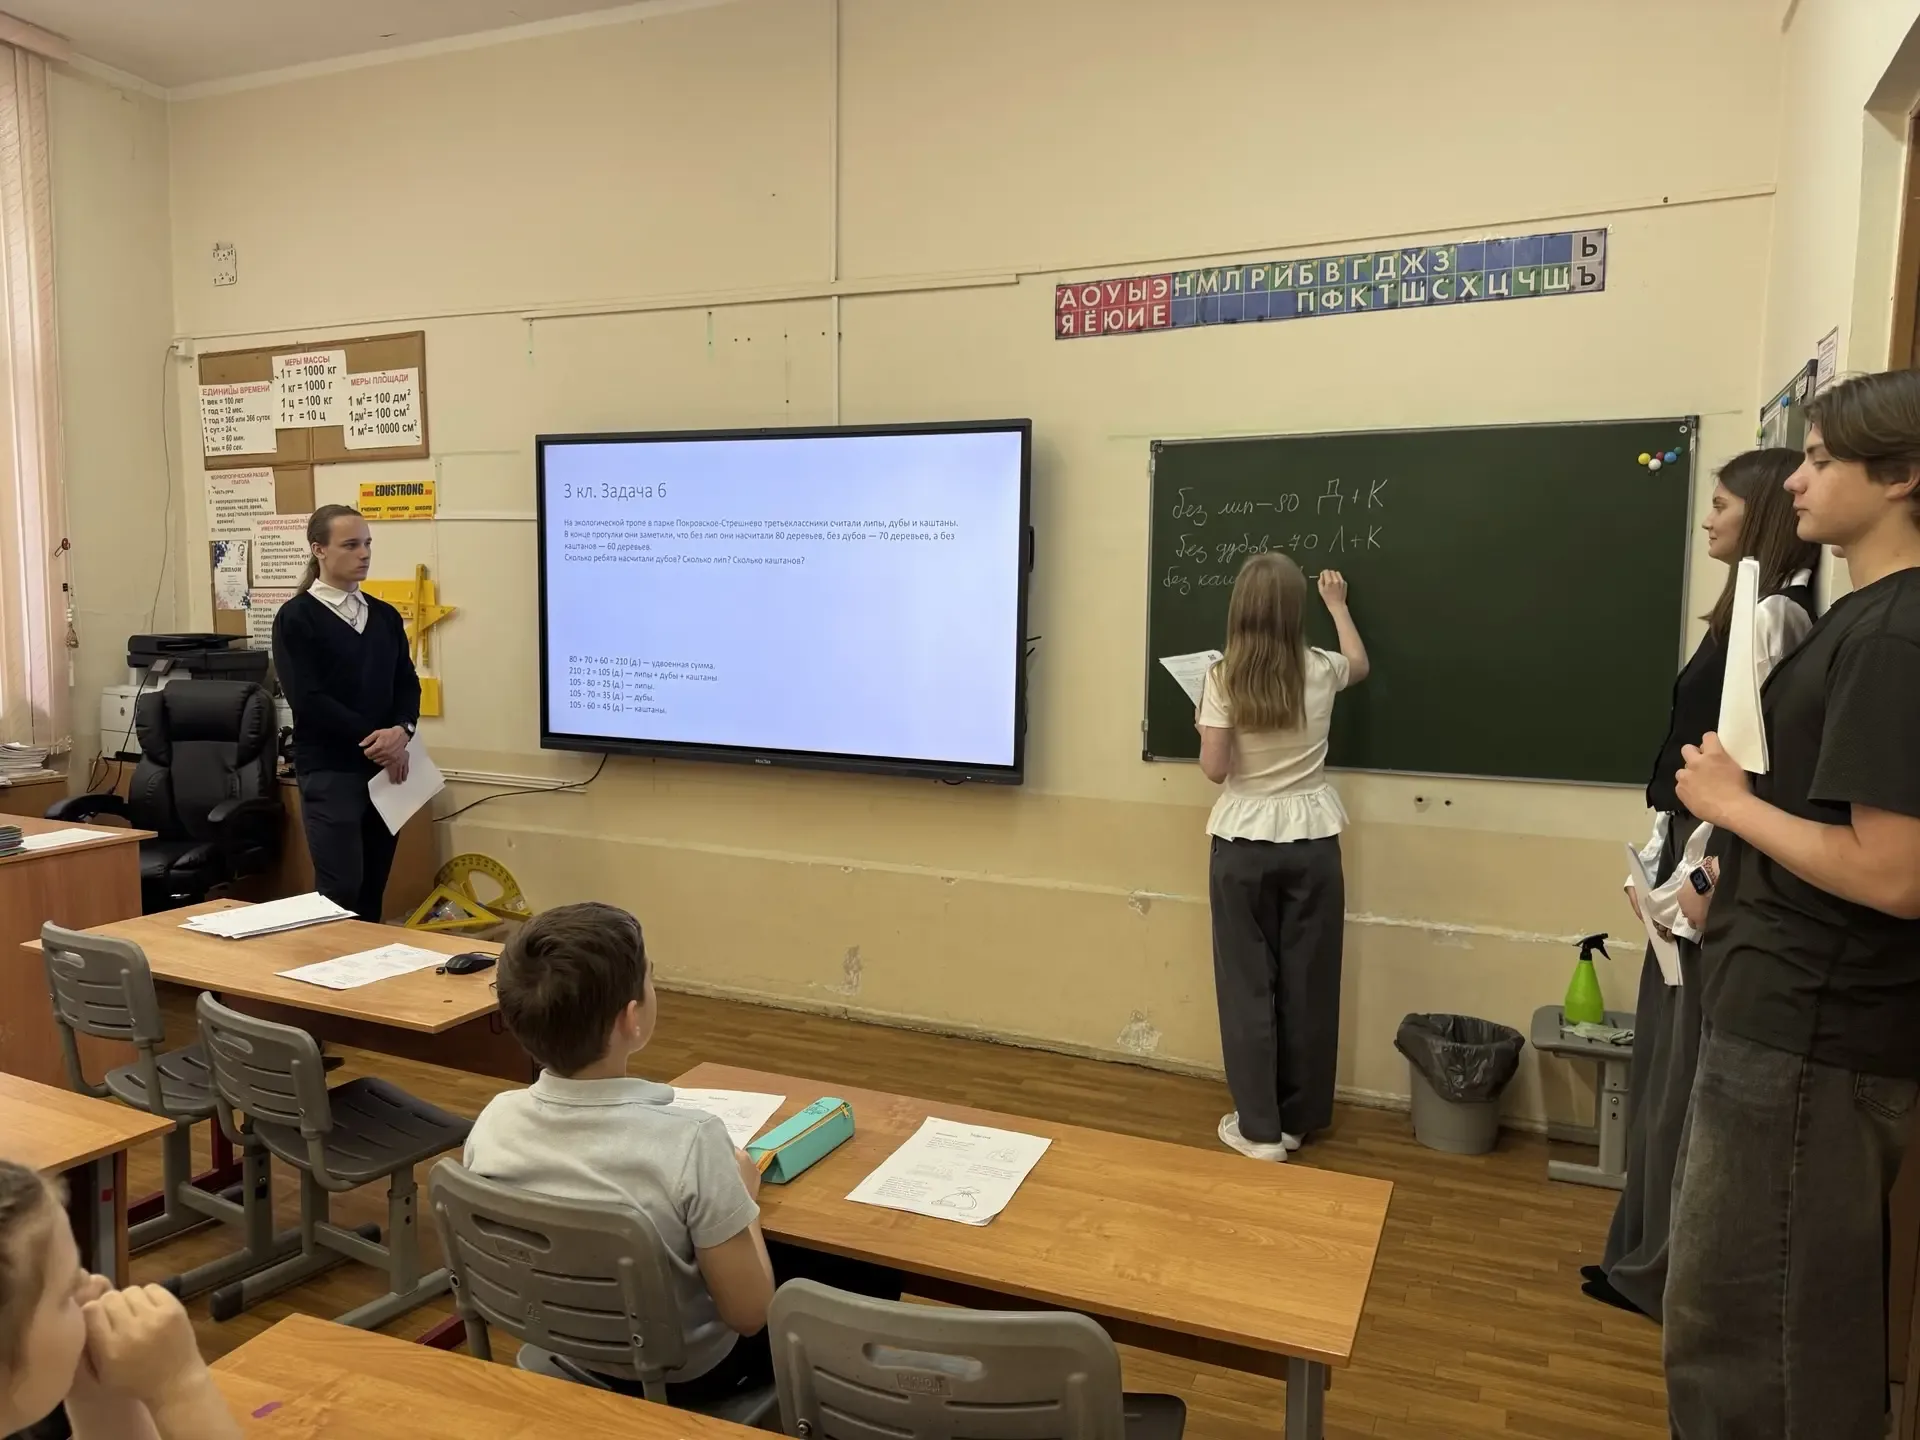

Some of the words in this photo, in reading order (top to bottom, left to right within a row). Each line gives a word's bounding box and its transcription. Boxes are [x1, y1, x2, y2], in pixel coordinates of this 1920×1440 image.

[285, 358, 302, 366] МЕРЫ
[281, 369, 284, 378] 1
[304, 365, 324, 376] 1000
[282, 384, 285, 393] 1
[305, 380, 325, 391] 1000
[351, 378, 371, 386] МЕРЫ
[373, 374, 408, 384] ПЛОЩАДИ
[203, 387, 238, 396] ЕДИНИЦЫ
[240, 385, 270, 394] ВРЕМЕНИ
[282, 398, 285, 408] 1
[289, 400, 294, 409] ц
[306, 395, 320, 406] 100
[348, 396, 352, 406] 1
[375, 392, 390, 403] 100
[281, 412, 285, 422] 1
[307, 410, 316, 420] 10
[320, 412, 326, 421] ц
[376, 408, 390, 418] 100
[350, 426, 354, 436] 1
[376, 422, 399, 434] 10000
[375, 483, 423, 496] EDUSTRONG
[564, 484, 571, 498] 3
[577, 487, 596, 498] кл.
[602, 483, 652, 501] Задача
[658, 483, 666, 498] 6
[1172, 487, 1208, 526] без
[1317, 478, 1343, 515] Д
[1368, 479, 1388, 508] К
[888, 519, 910, 528] дубы
[941, 532, 955, 540] без
[1176, 534, 1208, 563] без
[1367, 525, 1382, 550] К
[1163, 566, 1191, 595] без
